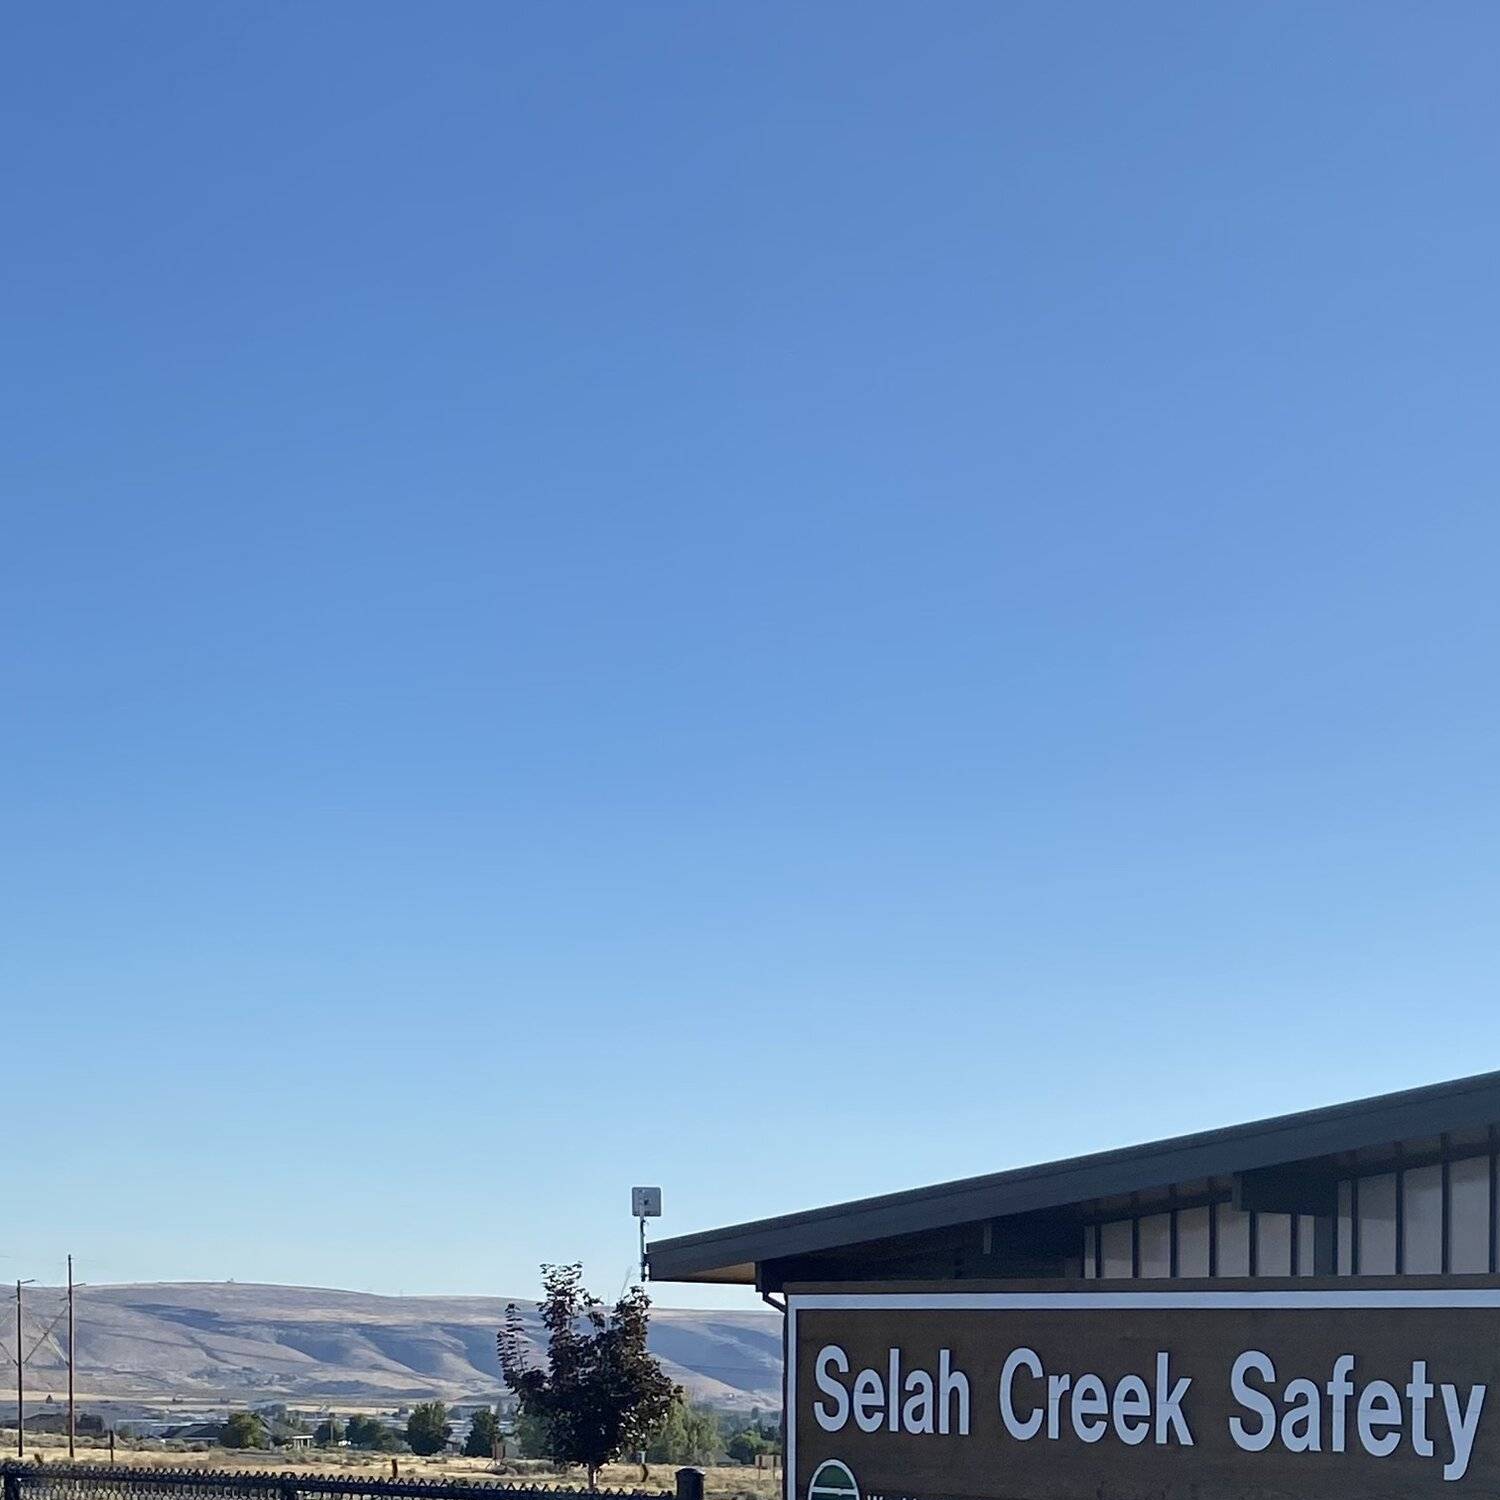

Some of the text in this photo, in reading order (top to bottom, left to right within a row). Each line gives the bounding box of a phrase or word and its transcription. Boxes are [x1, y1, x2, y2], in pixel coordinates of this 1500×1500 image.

[813, 1345, 970, 1436] Selah
[999, 1347, 1195, 1447] Creek
[1229, 1350, 1487, 1482] Safety
